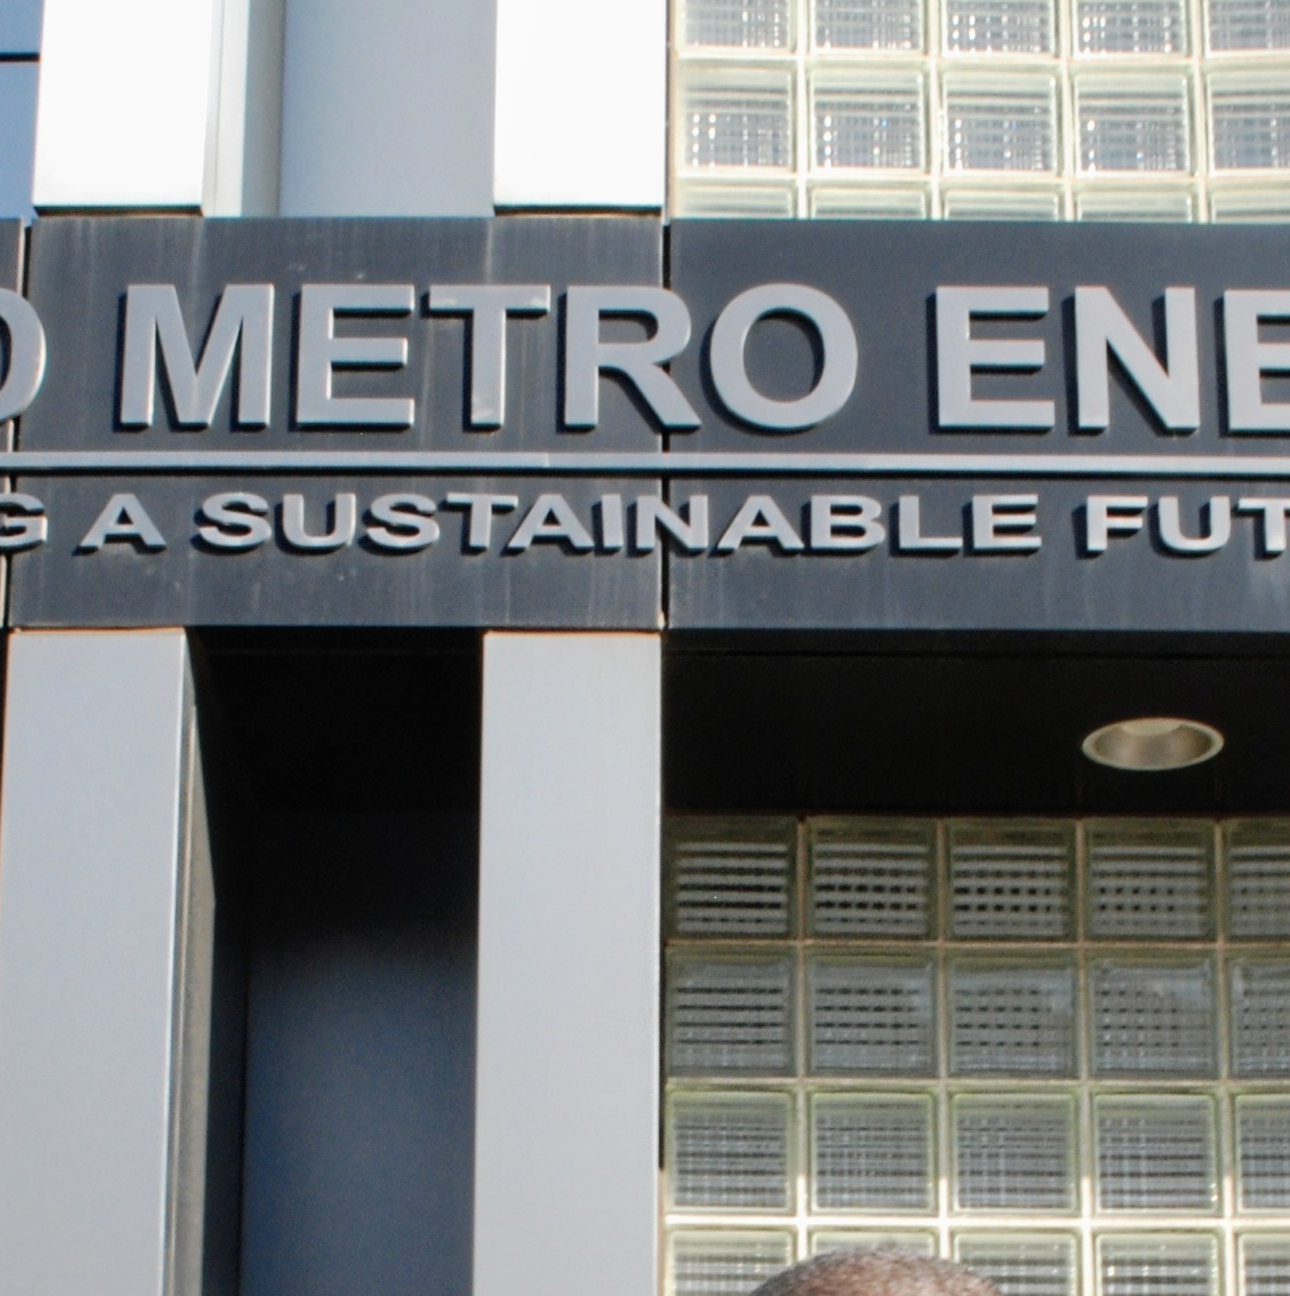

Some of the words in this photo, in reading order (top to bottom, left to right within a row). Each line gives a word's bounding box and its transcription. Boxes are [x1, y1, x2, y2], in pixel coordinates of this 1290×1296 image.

[117, 283, 859, 431] METRO
[78, 493, 166, 552] A
[198, 492, 1043, 555] SUSTAINABLE
